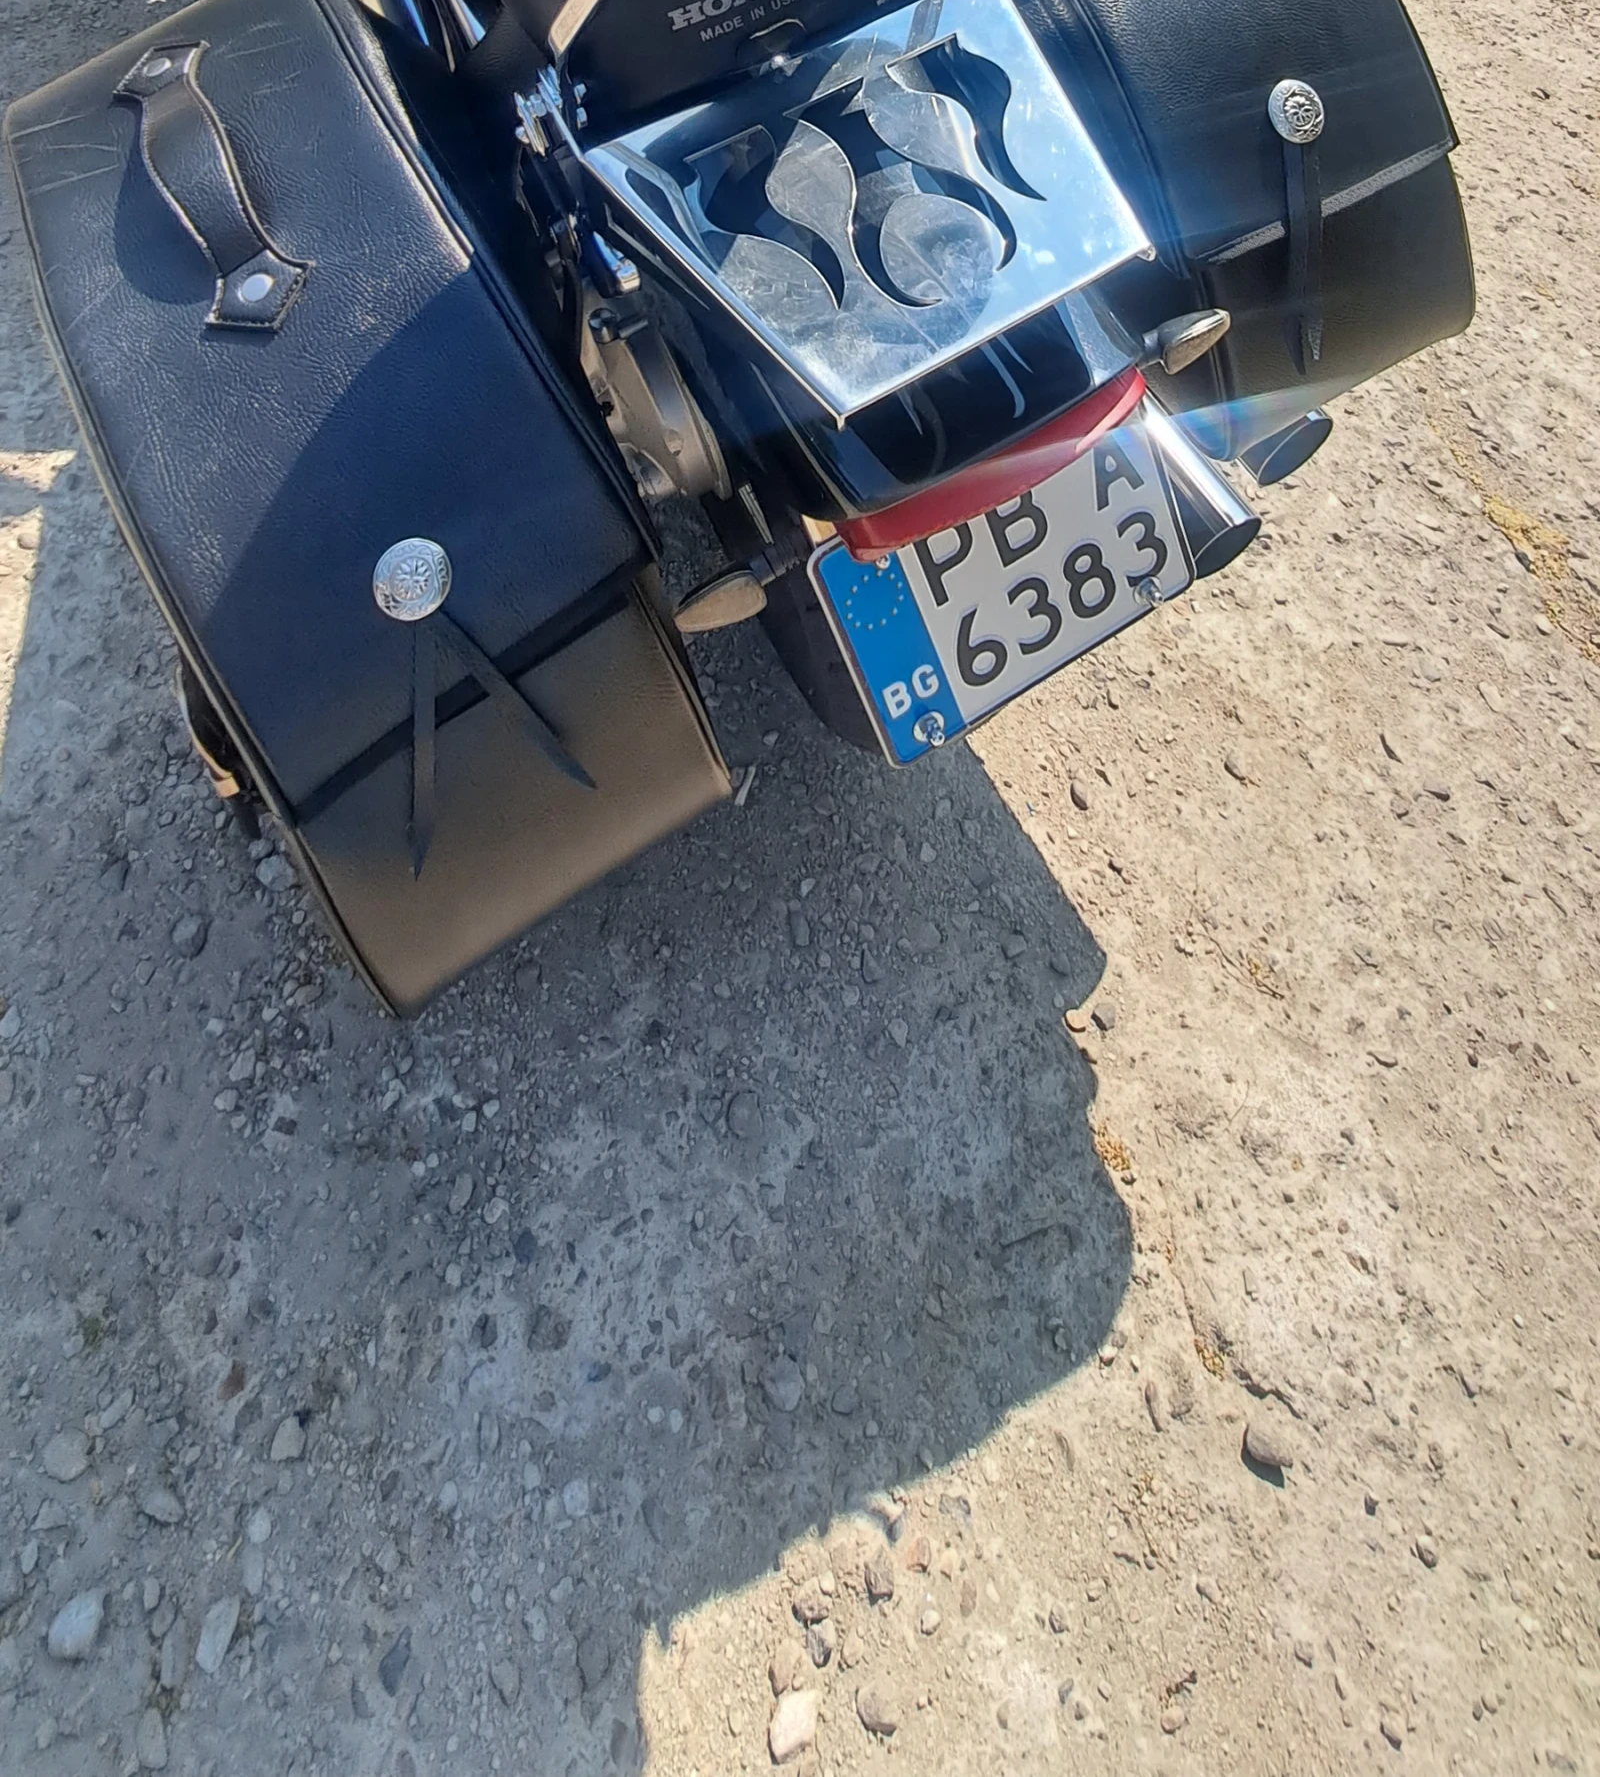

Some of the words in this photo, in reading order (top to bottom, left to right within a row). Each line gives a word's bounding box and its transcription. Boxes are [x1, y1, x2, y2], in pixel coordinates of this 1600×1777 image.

[700, 16, 744, 42] MADE
[750, 5, 766, 21] IN
[912, 488, 1048, 607] PB
[1094, 438, 1145, 512] A
[957, 511, 1168, 687] 6383
[882, 664, 940, 719] BG
